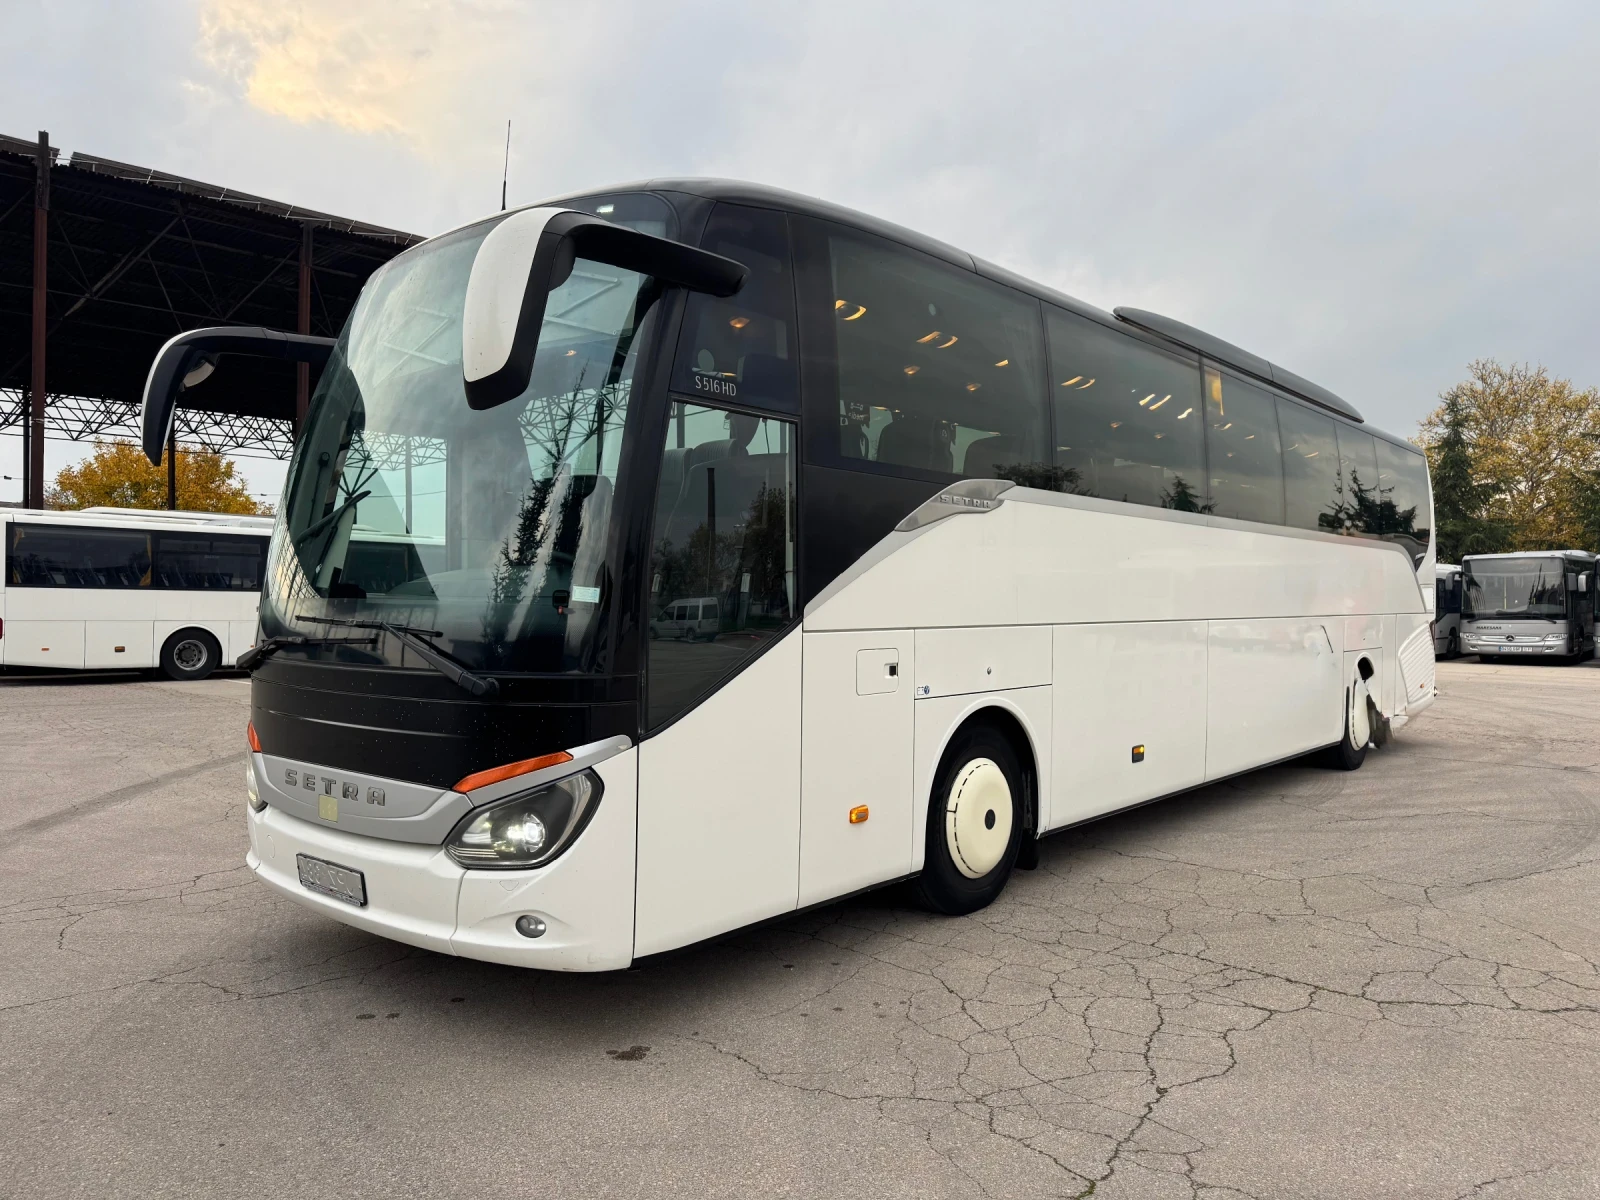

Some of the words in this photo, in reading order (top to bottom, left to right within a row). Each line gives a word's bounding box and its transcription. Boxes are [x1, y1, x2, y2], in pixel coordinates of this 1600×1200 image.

[695, 375, 702, 389] S
[703, 377, 720, 393] 516
[721, 381, 737, 396] HD
[939, 494, 991, 509] SETRA
[284, 767, 386, 806] SETRA
